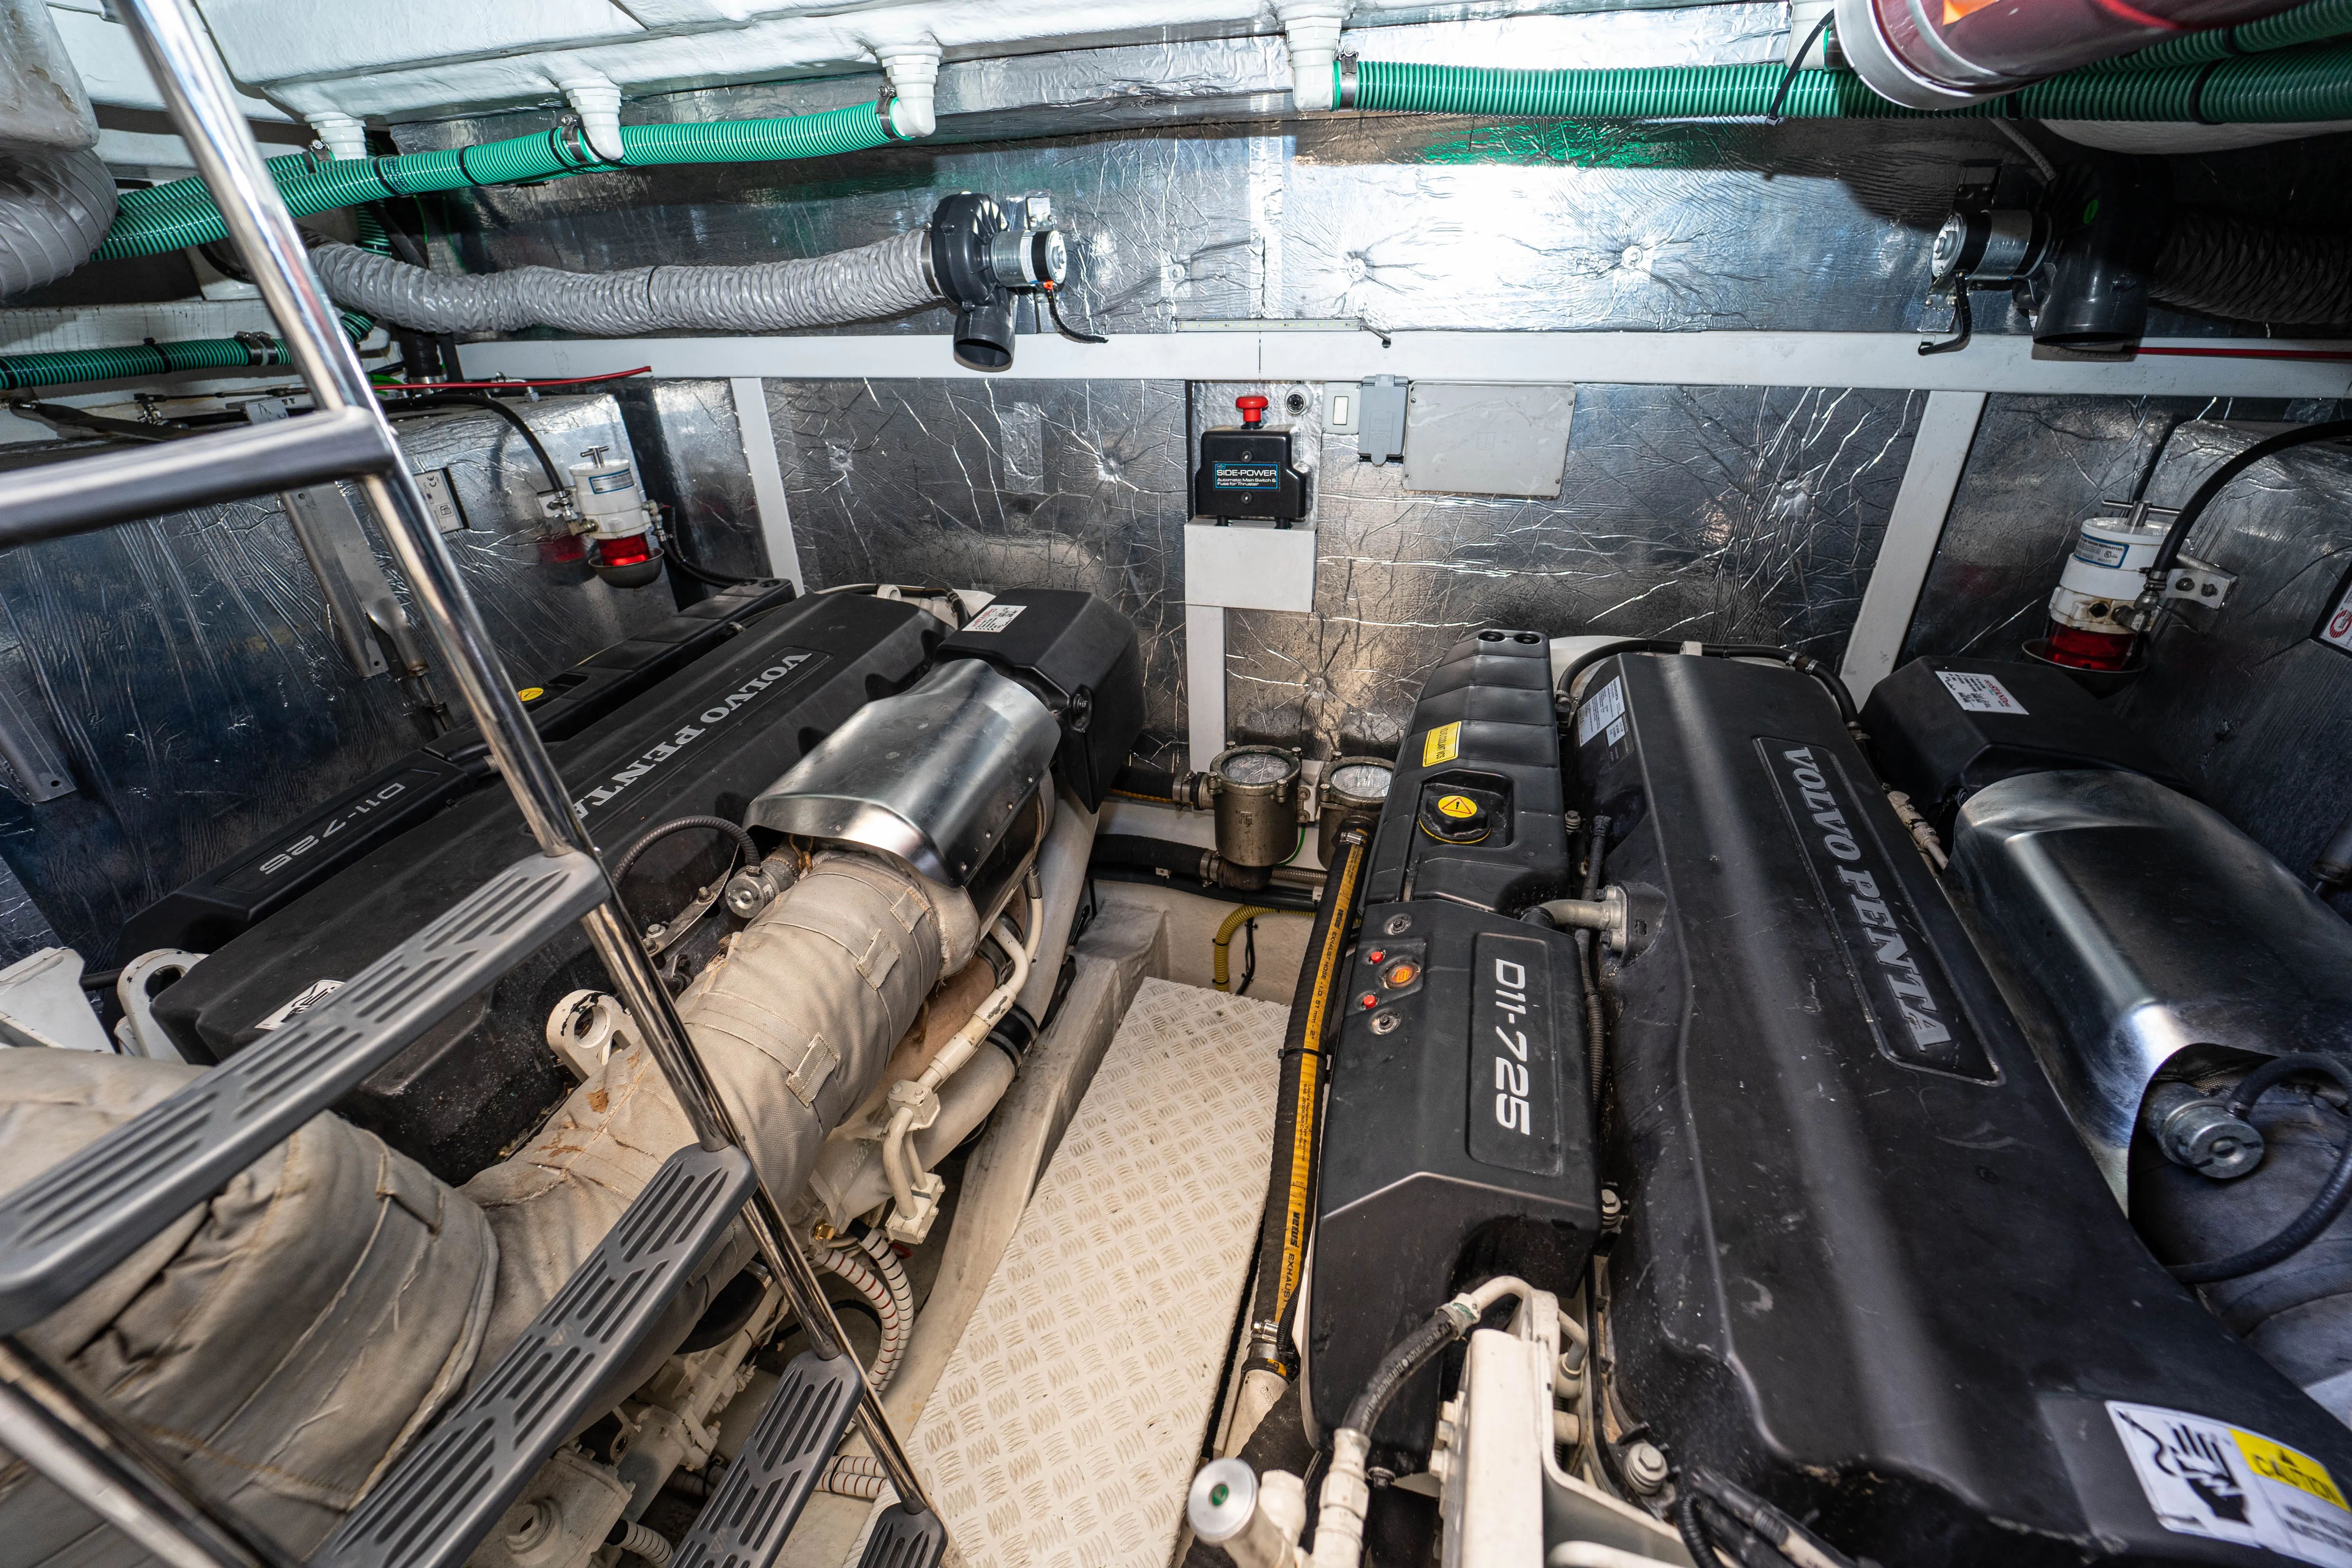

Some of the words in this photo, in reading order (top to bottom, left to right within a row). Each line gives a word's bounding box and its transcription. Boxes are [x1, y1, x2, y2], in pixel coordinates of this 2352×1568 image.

[700, 652, 813, 724] VOLVO
[1436, 750, 1445, 759] VCS
[259, 782, 406, 875] D11-725
[1782, 746, 1861, 862] VOLVO
[1837, 866, 1953, 1053] PENTA
[1327, 931, 1337, 961] EXHAUST
[1311, 1010, 1318, 1024] mm
[1315, 999, 1321, 1009] 51
[1494, 958, 1531, 1136] D11-725
[1283, 1253, 1295, 1305] EXHAUST
